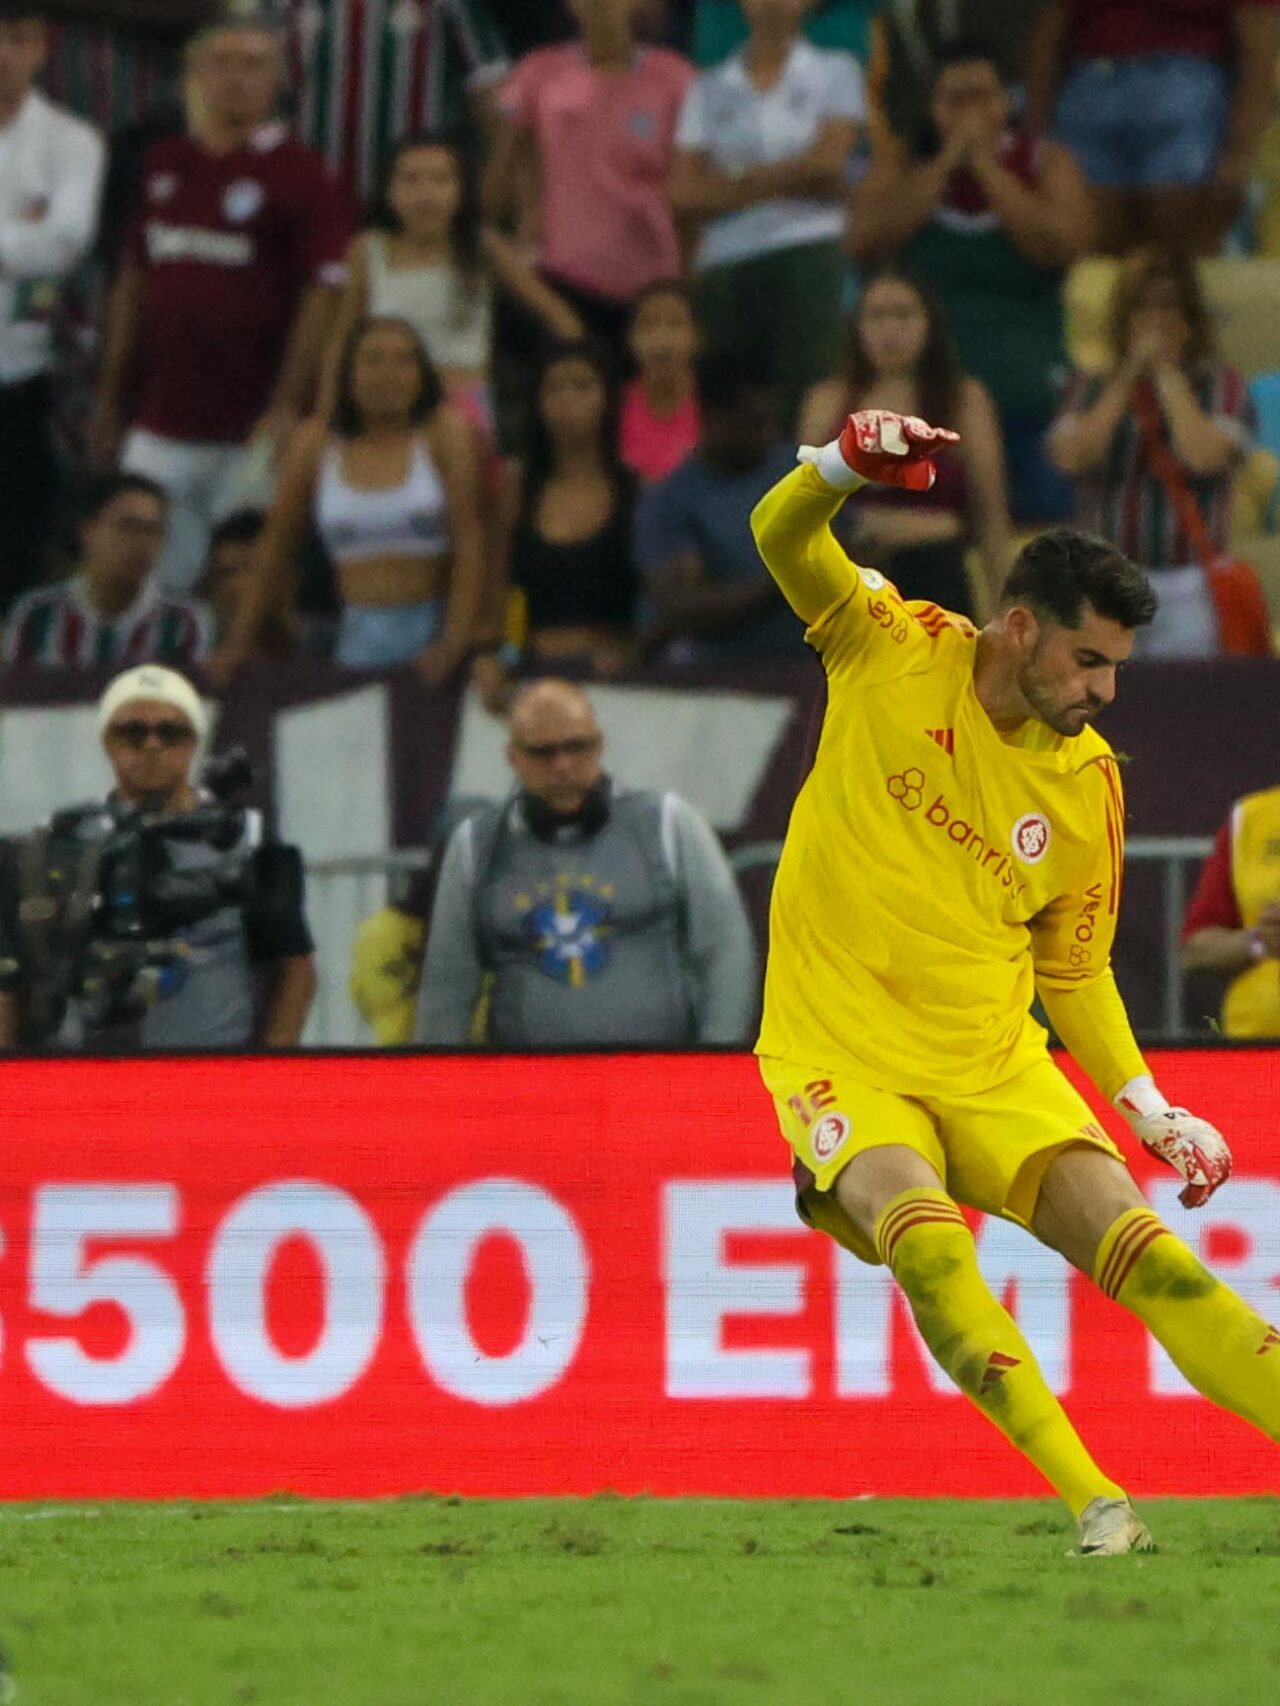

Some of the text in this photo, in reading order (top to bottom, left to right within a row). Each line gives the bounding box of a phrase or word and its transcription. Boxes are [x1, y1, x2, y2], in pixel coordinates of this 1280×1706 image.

[924, 794, 1027, 900] banris
[1075, 882, 1102, 943] vero
[788, 1078, 838, 1127] 12
[0, 1176, 591, 1408] 500
[663, 1176, 1072, 1397] EM
